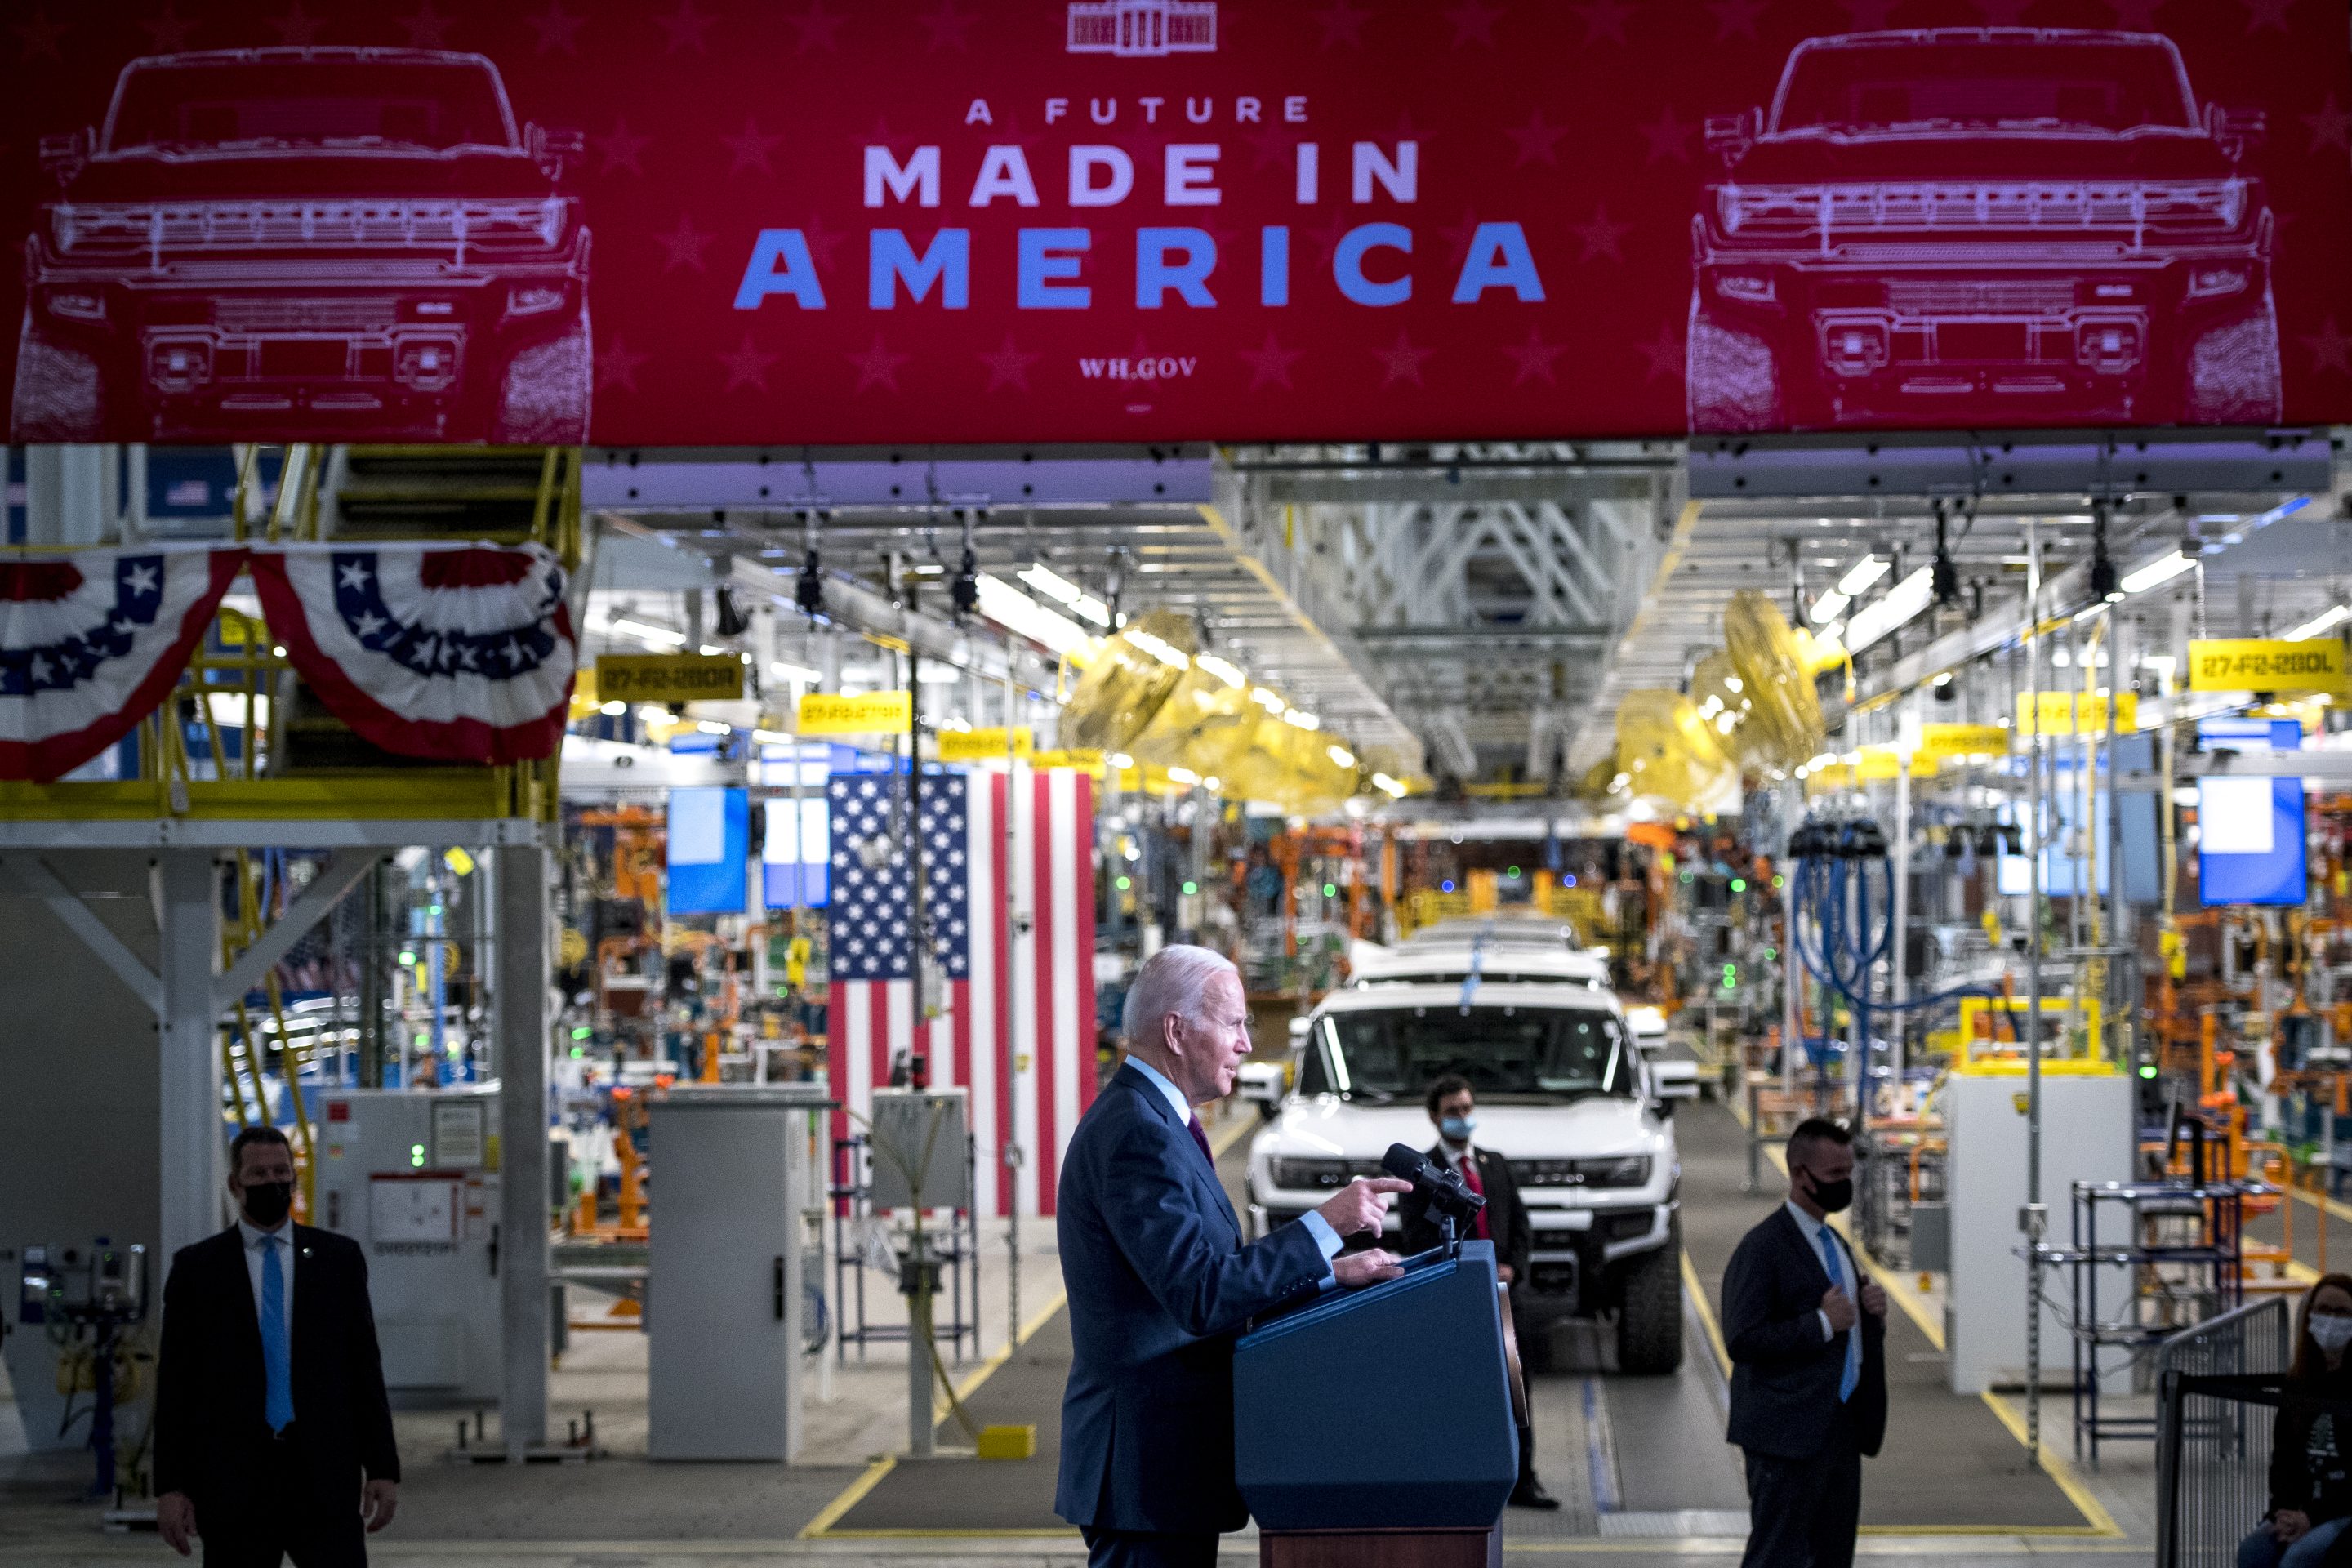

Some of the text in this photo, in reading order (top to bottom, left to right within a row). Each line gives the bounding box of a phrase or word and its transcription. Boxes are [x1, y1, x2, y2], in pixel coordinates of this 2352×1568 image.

[965, 96, 1308, 126] A FUTURE
[862, 140, 1419, 208] MADE IN
[733, 222, 1546, 310] AMERICA
[1079, 356, 1198, 381] WH.GOV
